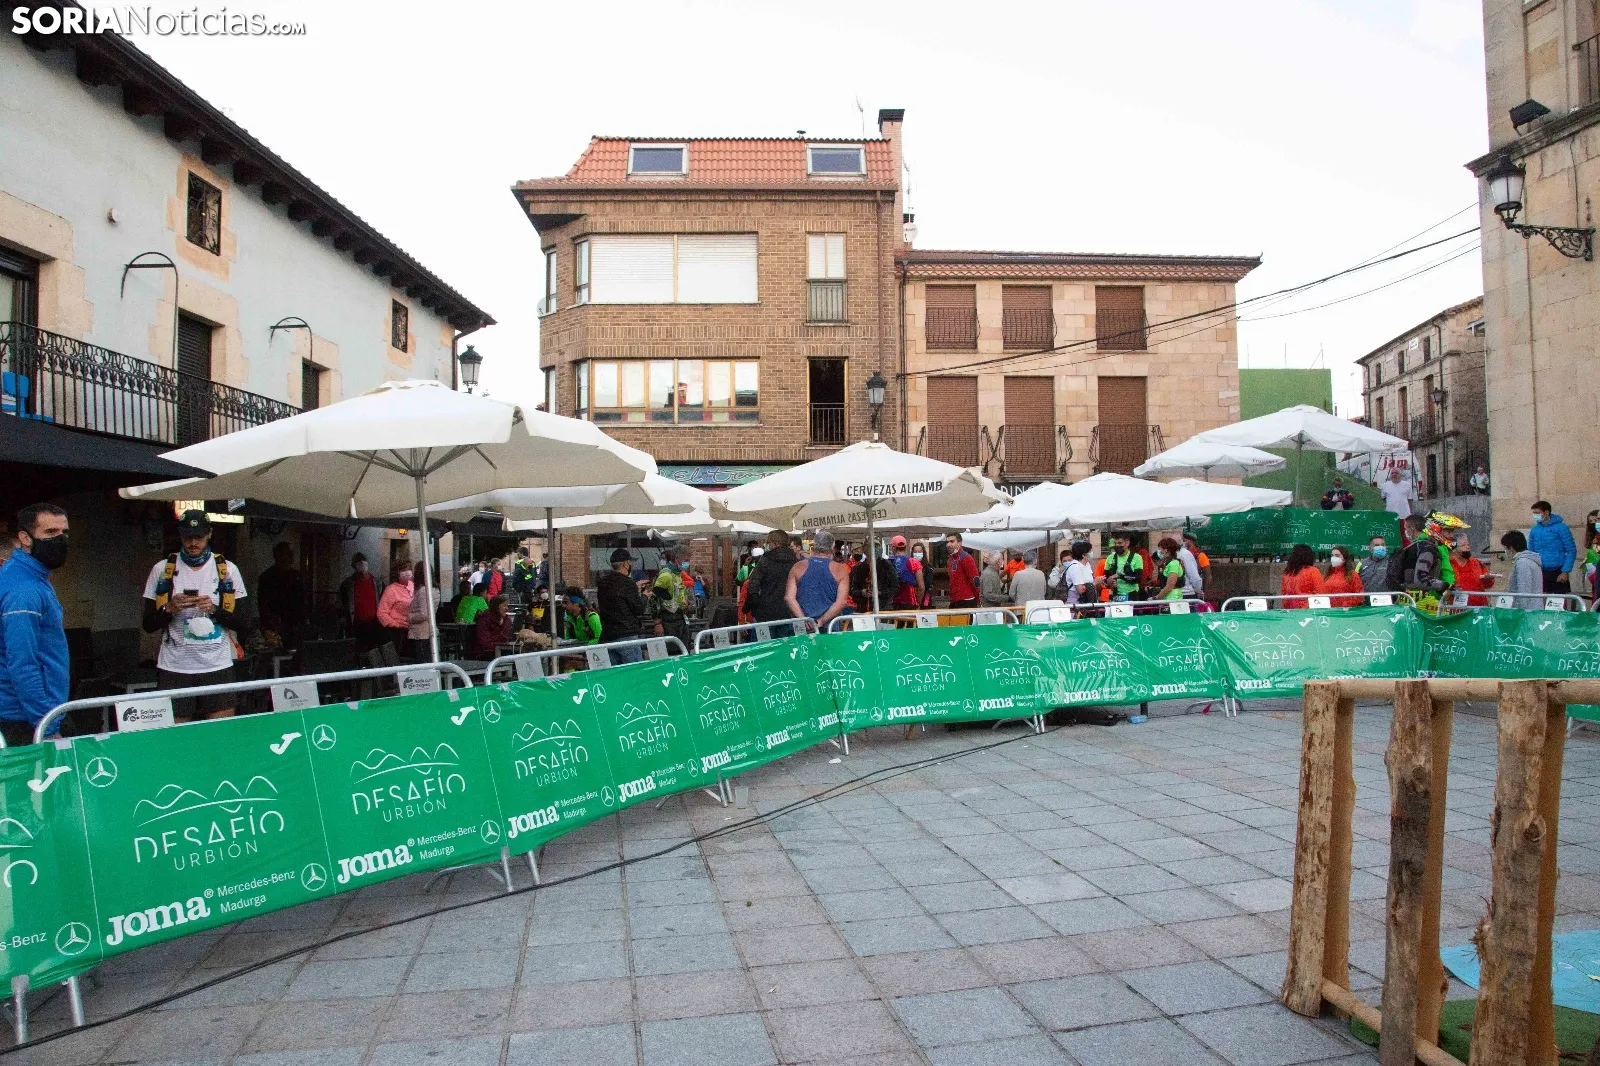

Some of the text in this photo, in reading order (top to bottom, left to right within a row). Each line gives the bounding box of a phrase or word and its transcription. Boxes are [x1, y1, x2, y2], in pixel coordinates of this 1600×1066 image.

[846, 483, 897, 497] CERVEZAS
[1244, 648, 1305, 663] DESAFÍO
[1336, 642, 1396, 659] DESAFÍO
[896, 669, 957, 687] DESAFÍO
[985, 663, 1042, 681] DESAFÍO
[699, 701, 746, 730] DESAFÍO
[618, 719, 677, 752] DESAFÍO
[514, 742, 589, 780] DESAFÍO
[351, 769, 466, 815] DESAFÍO
[560, 790, 599, 808] Mercedes-Benz
[382, 797, 447, 823] URBIÓN
[133, 806, 285, 863] DESAFÍO
[417, 825, 477, 846] Mercedes-Benz
[173, 840, 258, 871] URBIÓN
[419, 844, 455, 861] Madurga
[217, 869, 296, 898] Mercedes-Benz
[219, 893, 267, 914] Madurga
